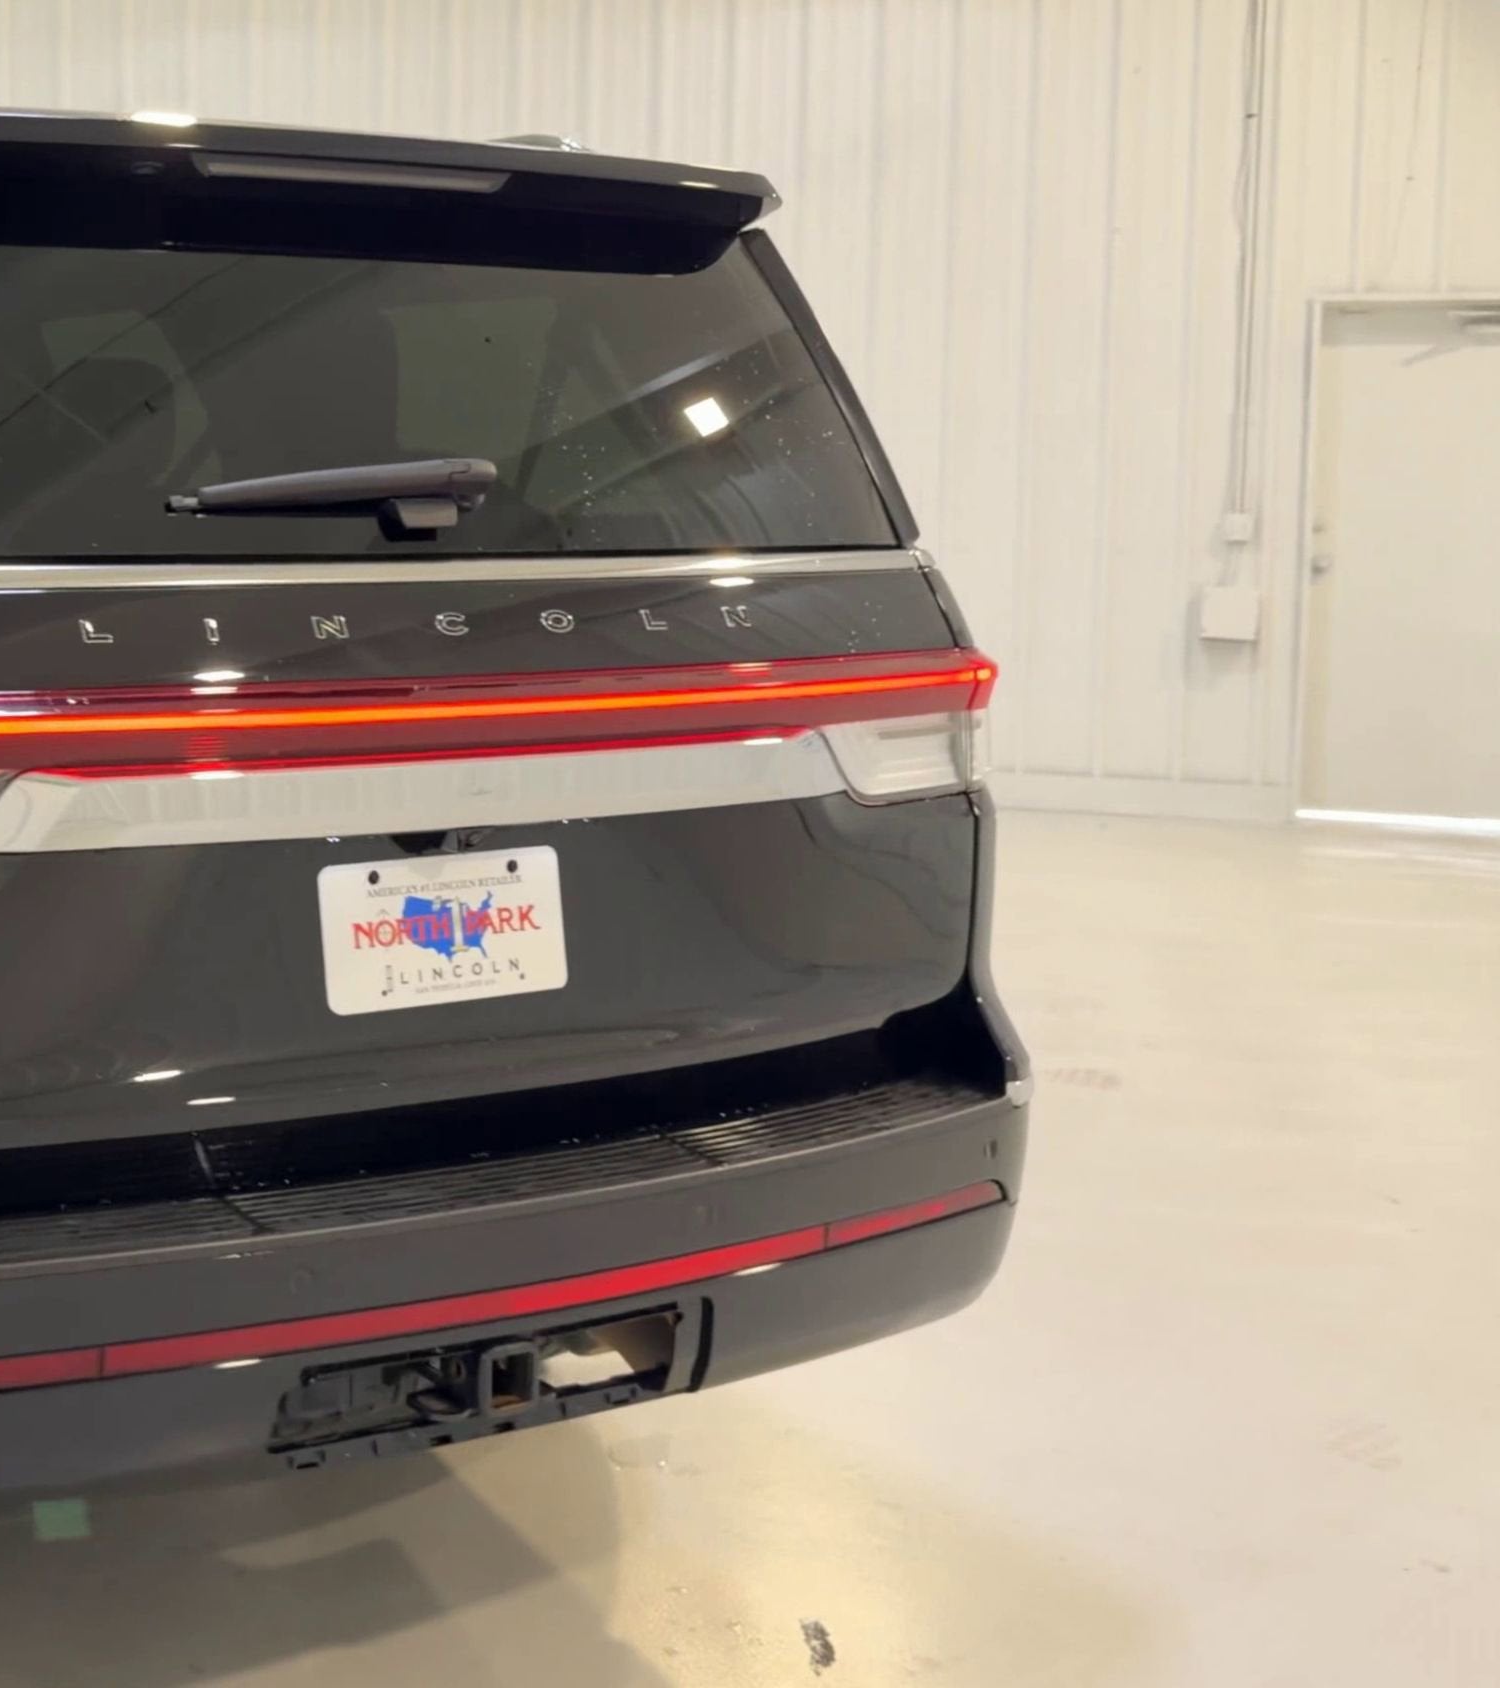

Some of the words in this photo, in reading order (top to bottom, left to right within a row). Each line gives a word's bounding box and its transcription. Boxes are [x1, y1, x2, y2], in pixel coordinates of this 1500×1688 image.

[78, 604, 752, 644] LINCOLN
[352, 912, 451, 949] NORTH
[465, 904, 541, 936] PARK
[400, 958, 521, 985] LINCOLN
